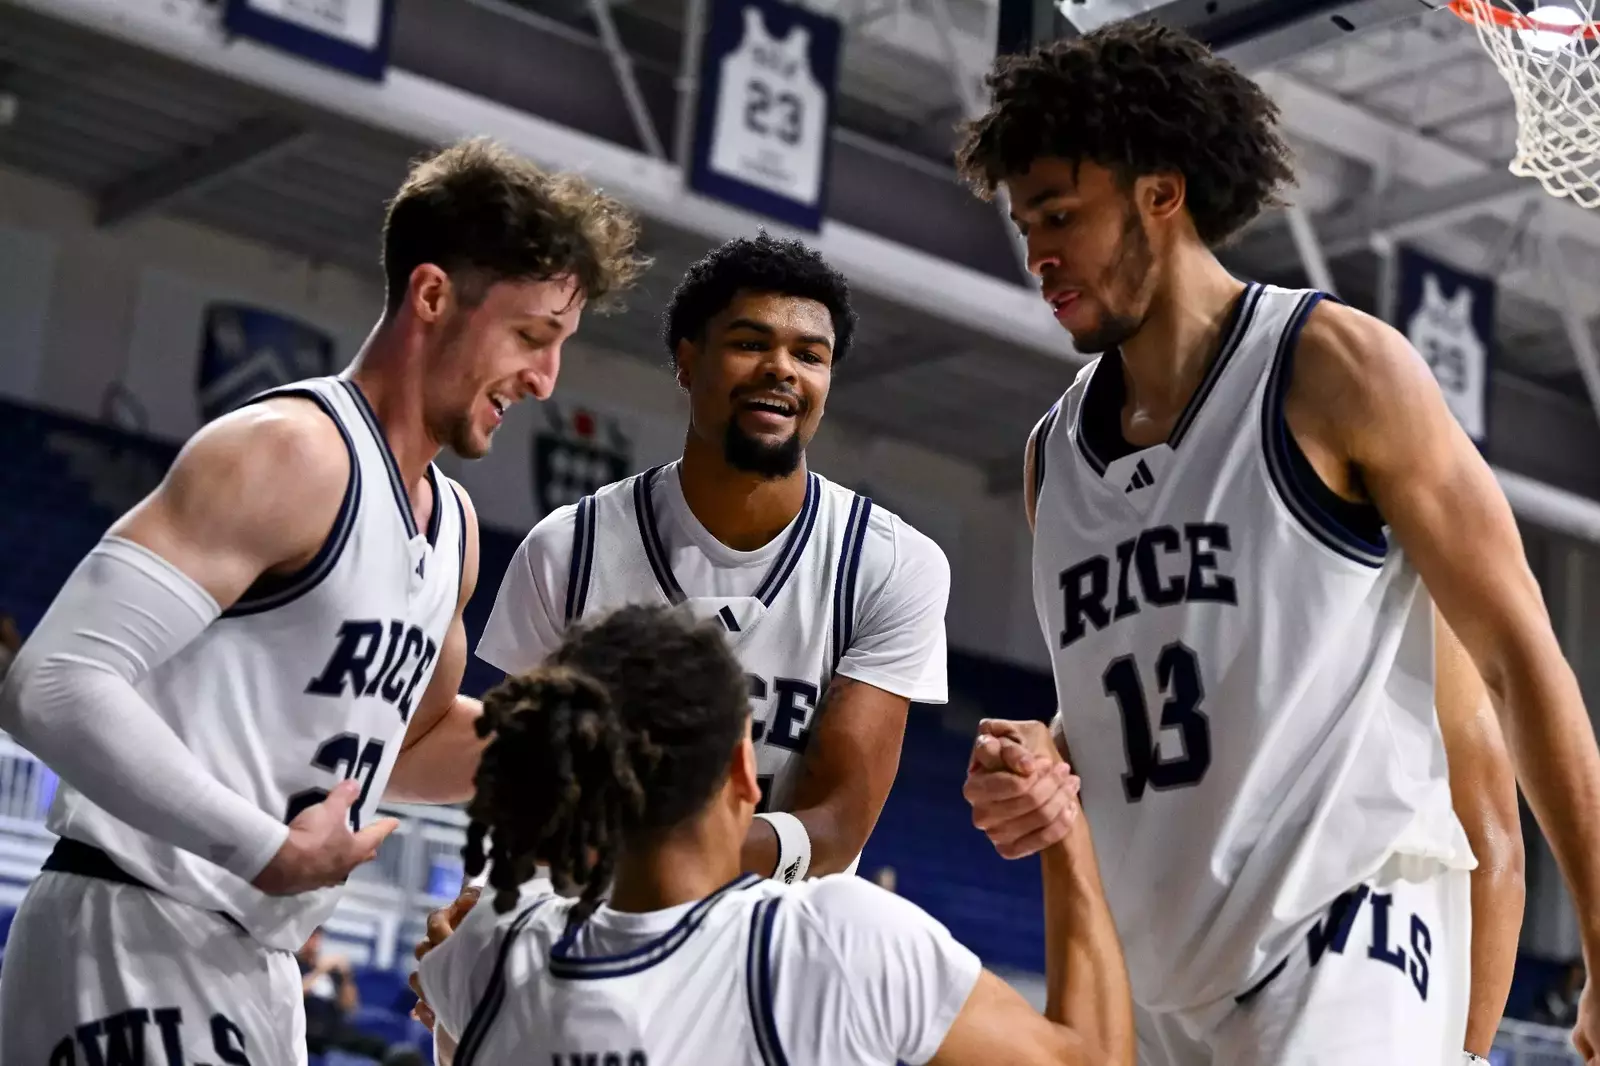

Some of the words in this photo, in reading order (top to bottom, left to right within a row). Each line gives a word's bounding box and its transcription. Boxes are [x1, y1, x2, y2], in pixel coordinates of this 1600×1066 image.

[745, 79, 804, 146] 23
[1058, 522, 1238, 649] RICE
[303, 619, 437, 725] RICE
[1101, 639, 1212, 804] 13
